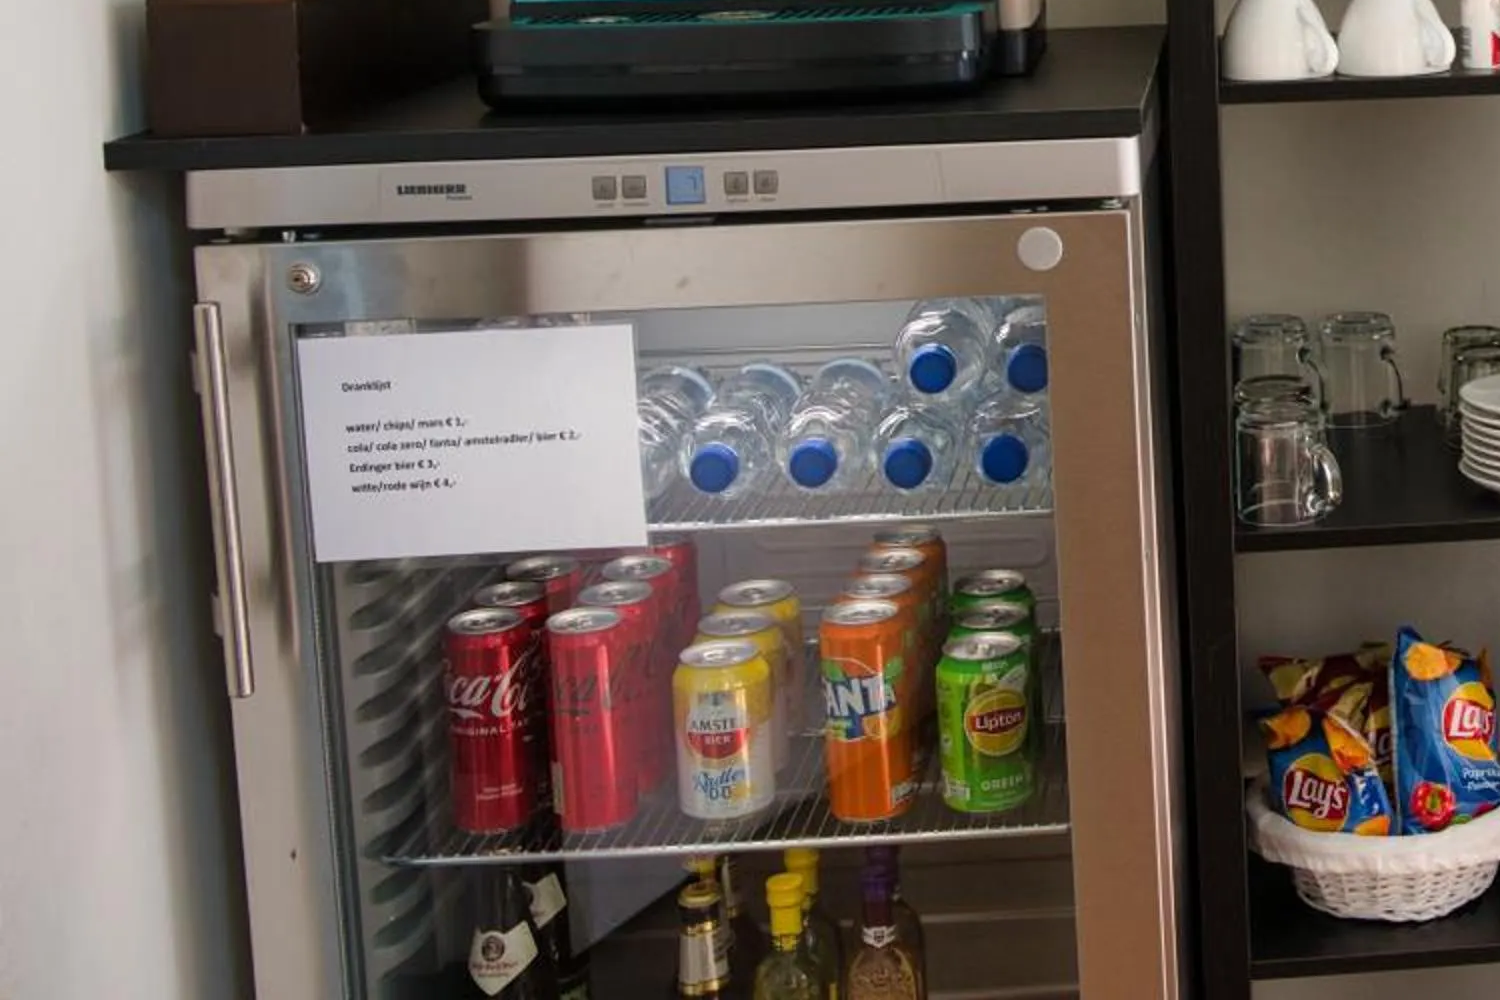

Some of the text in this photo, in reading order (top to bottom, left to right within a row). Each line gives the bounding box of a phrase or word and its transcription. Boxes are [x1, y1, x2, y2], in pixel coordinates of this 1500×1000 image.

[341, 380, 392, 393] Dranklijst
[346, 420, 381, 433] water/
[417, 419, 444, 429] mars
[536, 431, 557, 442] bier
[349, 461, 392, 474] Erdinger
[395, 460, 416, 470] bier
[409, 479, 433, 492] wijn
[824, 674, 896, 717] ANTA
[974, 710, 1021, 732] Lipton
